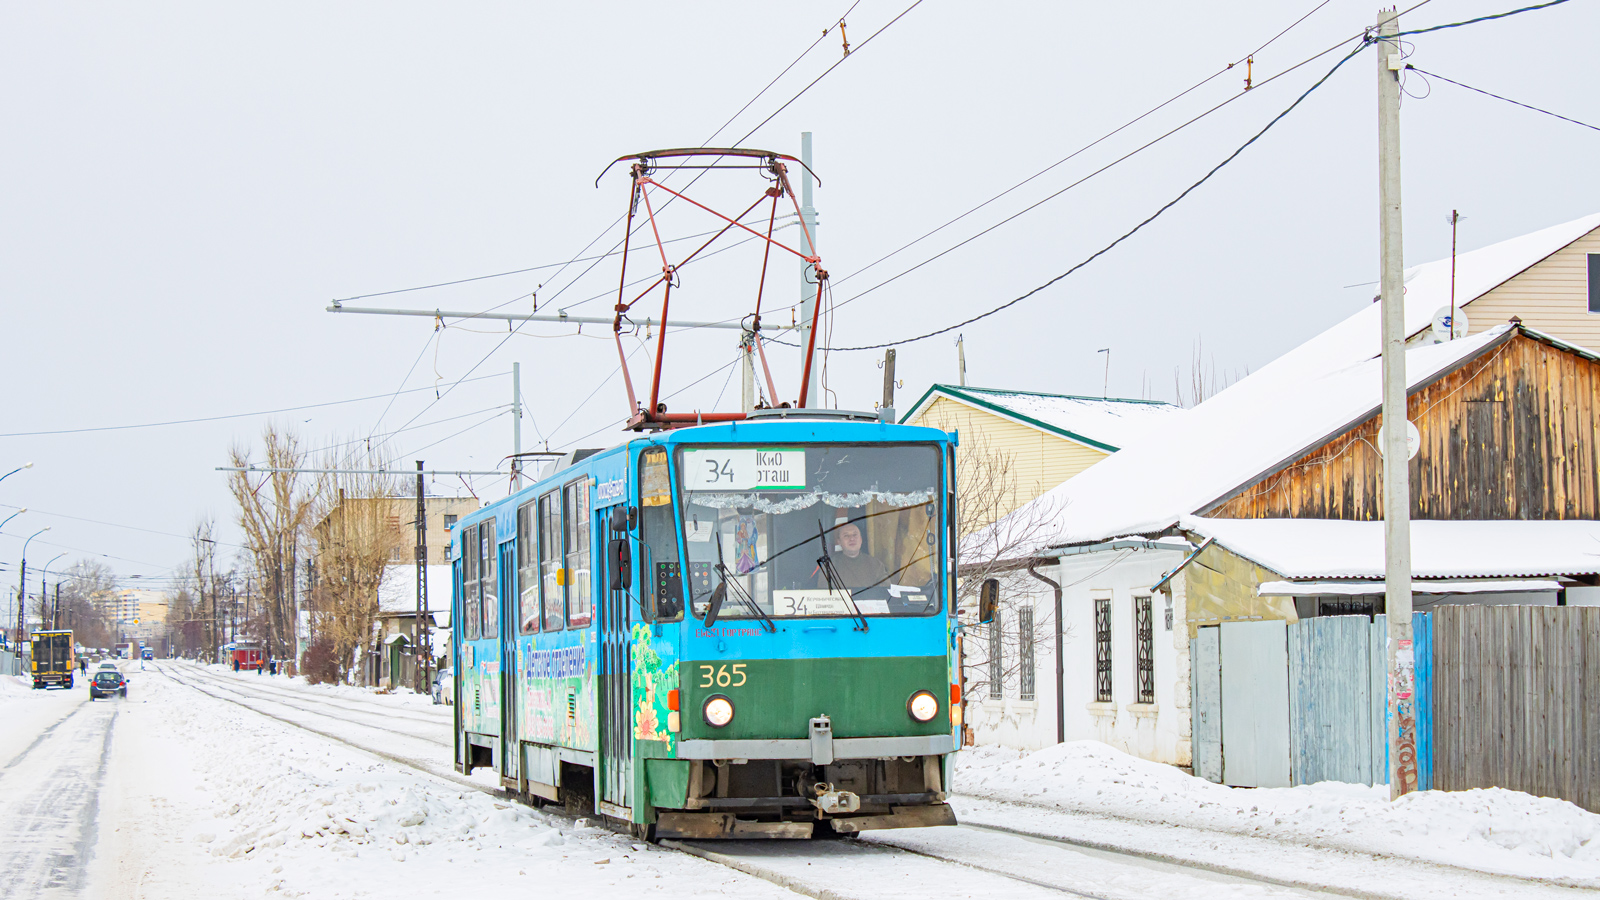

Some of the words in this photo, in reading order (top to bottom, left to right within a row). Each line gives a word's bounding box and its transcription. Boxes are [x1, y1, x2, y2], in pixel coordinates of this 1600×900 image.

[705, 459, 734, 483] 34
[783, 597, 807, 615] 34
[699, 663, 747, 688] 365
